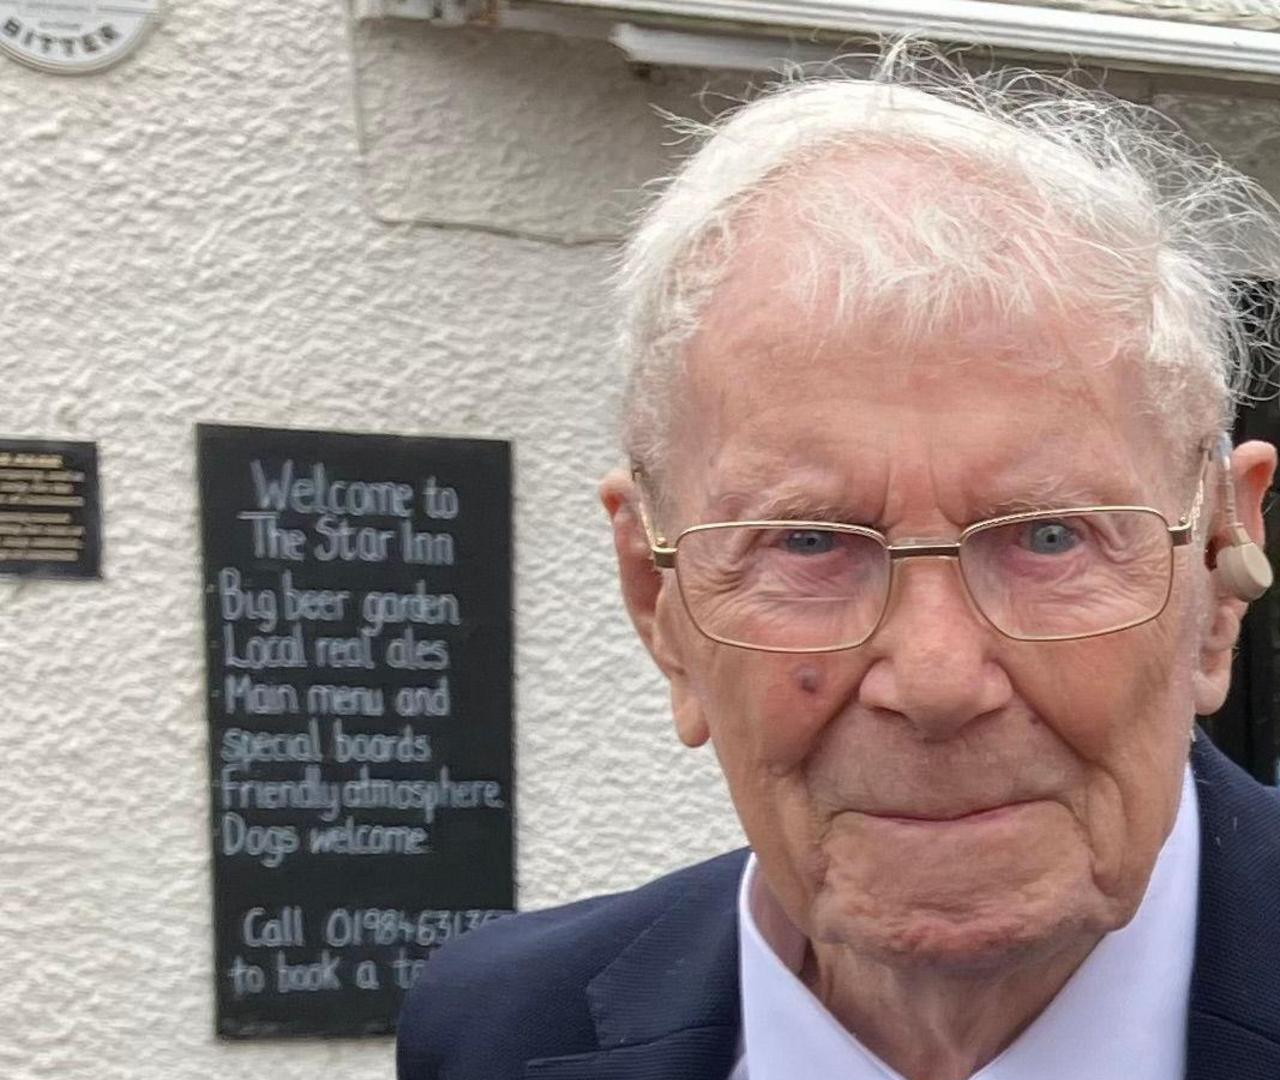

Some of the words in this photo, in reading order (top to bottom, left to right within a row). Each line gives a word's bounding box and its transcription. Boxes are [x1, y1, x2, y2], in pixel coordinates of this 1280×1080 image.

[3, 17, 120, 56] BITTER
[250, 458, 414, 517] Welcome
[422, 474, 459, 519] to
[236, 511, 307, 561] The
[314, 513, 397, 561] Star
[400, 519, 454, 566] Inn
[219, 566, 277, 632] Big
[283, 569, 350, 621] beer
[361, 579, 461, 637] garden
[223, 622, 307, 669] Local
[315, 630, 376, 669] real
[386, 627, 449, 669] ales
[224, 674, 299, 715] Main
[307, 683, 385, 716] menu
[395, 675, 450, 716] and
[333, 718, 432, 763] boards
[221, 762, 341, 821] Friendly
[222, 811, 300, 868] Dogs
[309, 816, 431, 855] welcome
[243, 906, 305, 947] Call
[229, 954, 266, 995] to
[277, 950, 342, 993] book
[355, 960, 380, 990] a
